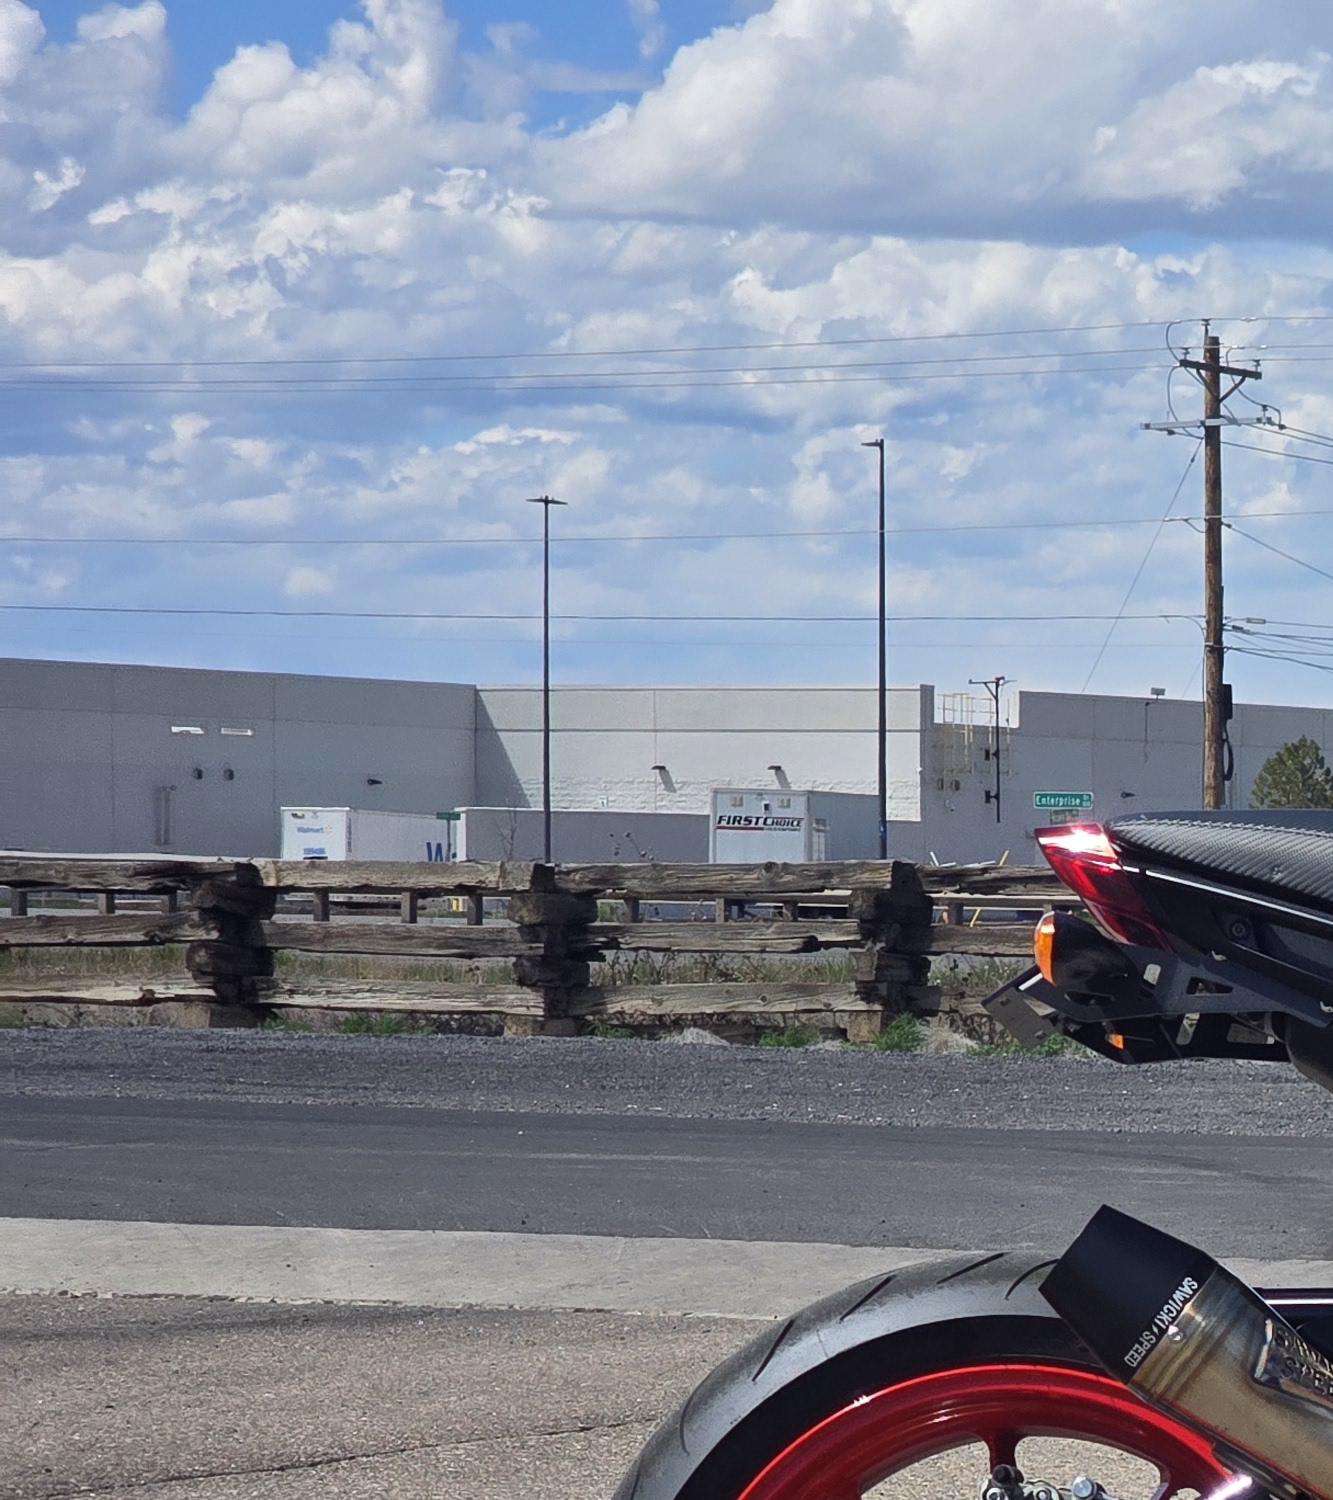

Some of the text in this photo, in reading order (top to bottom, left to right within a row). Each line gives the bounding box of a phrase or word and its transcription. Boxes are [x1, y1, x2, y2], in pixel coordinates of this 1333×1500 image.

[1036, 795, 1081, 807] Enterprise
[1124, 1277, 1198, 1367] SAWICKI SPEED
